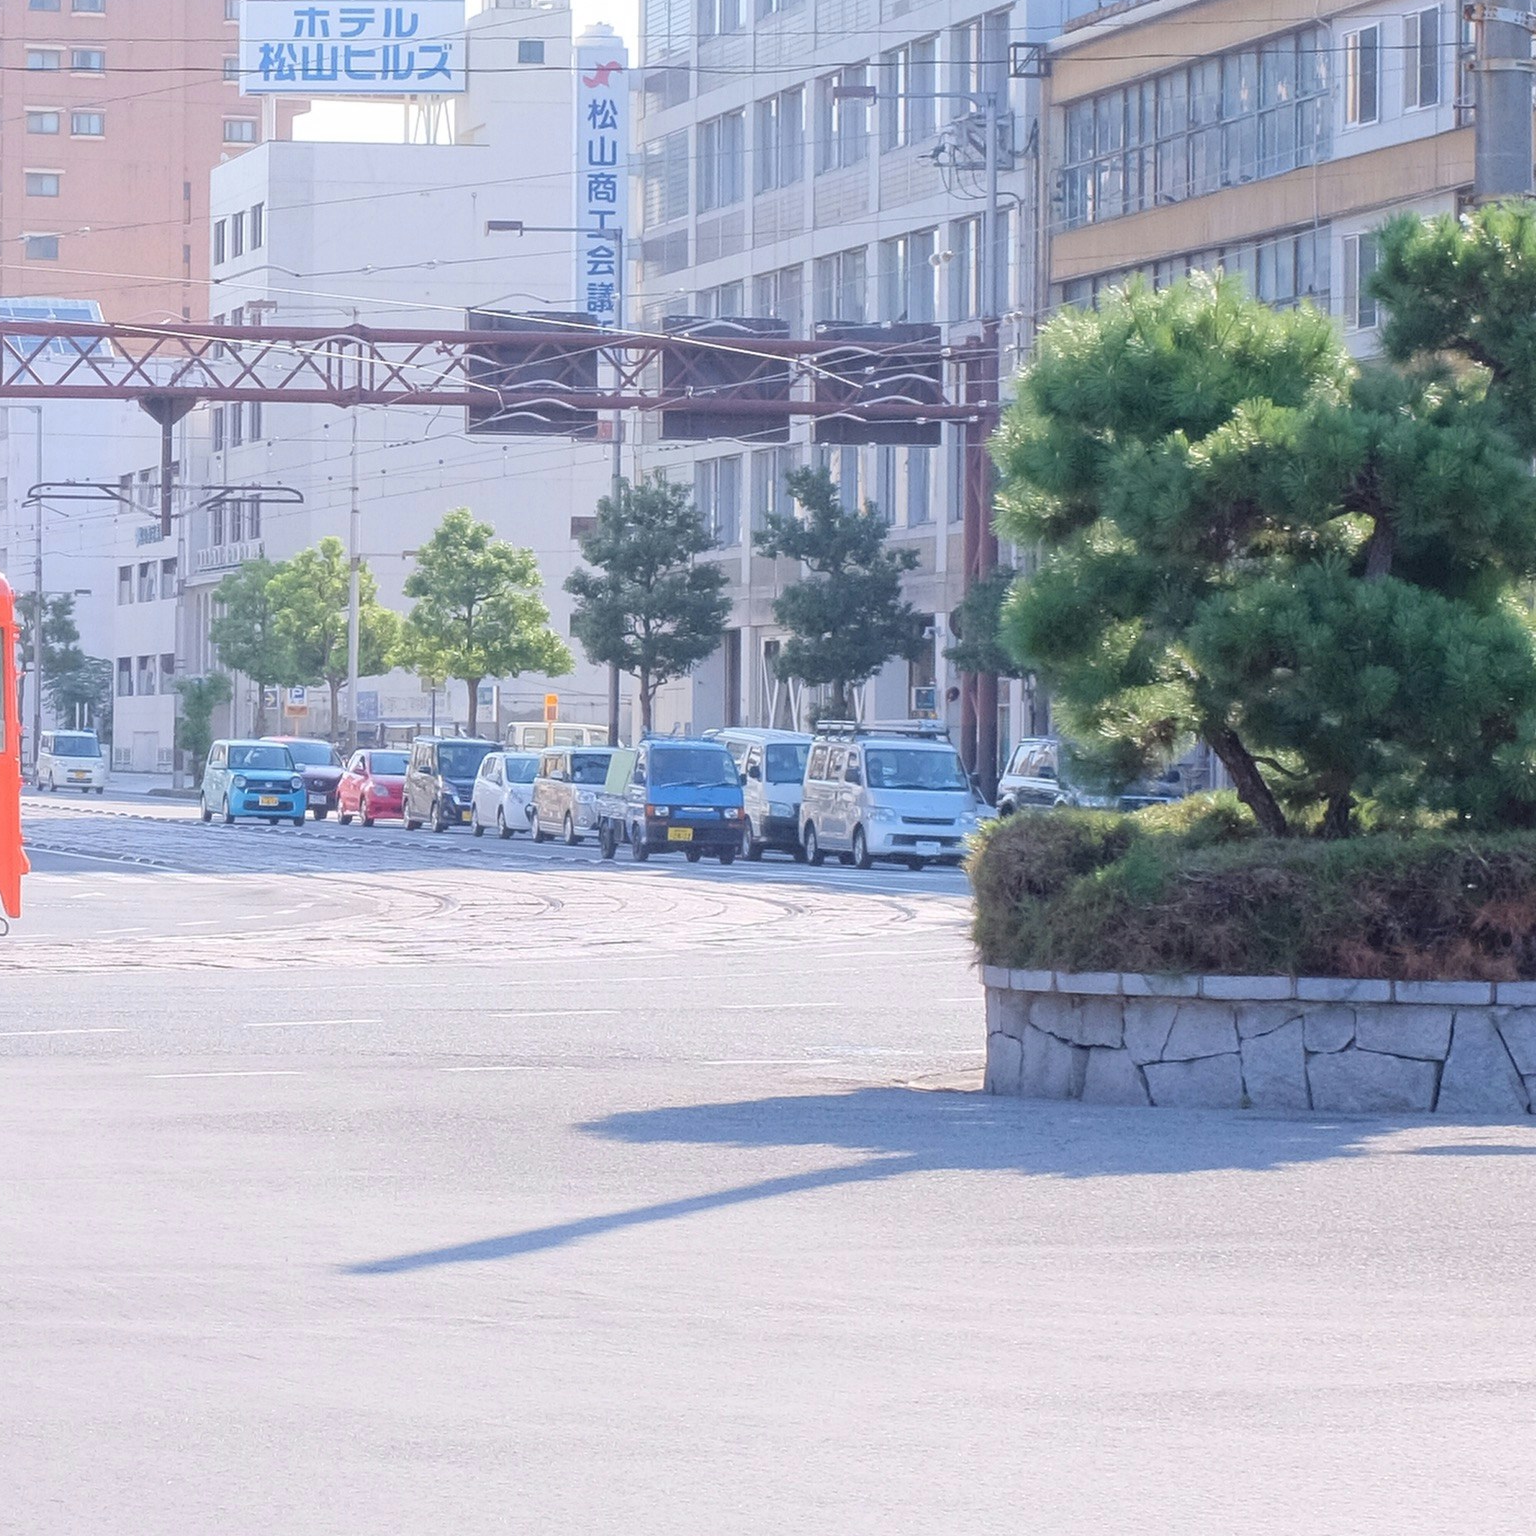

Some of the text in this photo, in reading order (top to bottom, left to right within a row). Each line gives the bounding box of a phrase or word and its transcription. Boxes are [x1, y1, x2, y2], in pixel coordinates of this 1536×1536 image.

[293, 6, 419, 39] ホテル
[258, 42, 453, 82] 松山ヒルズ
